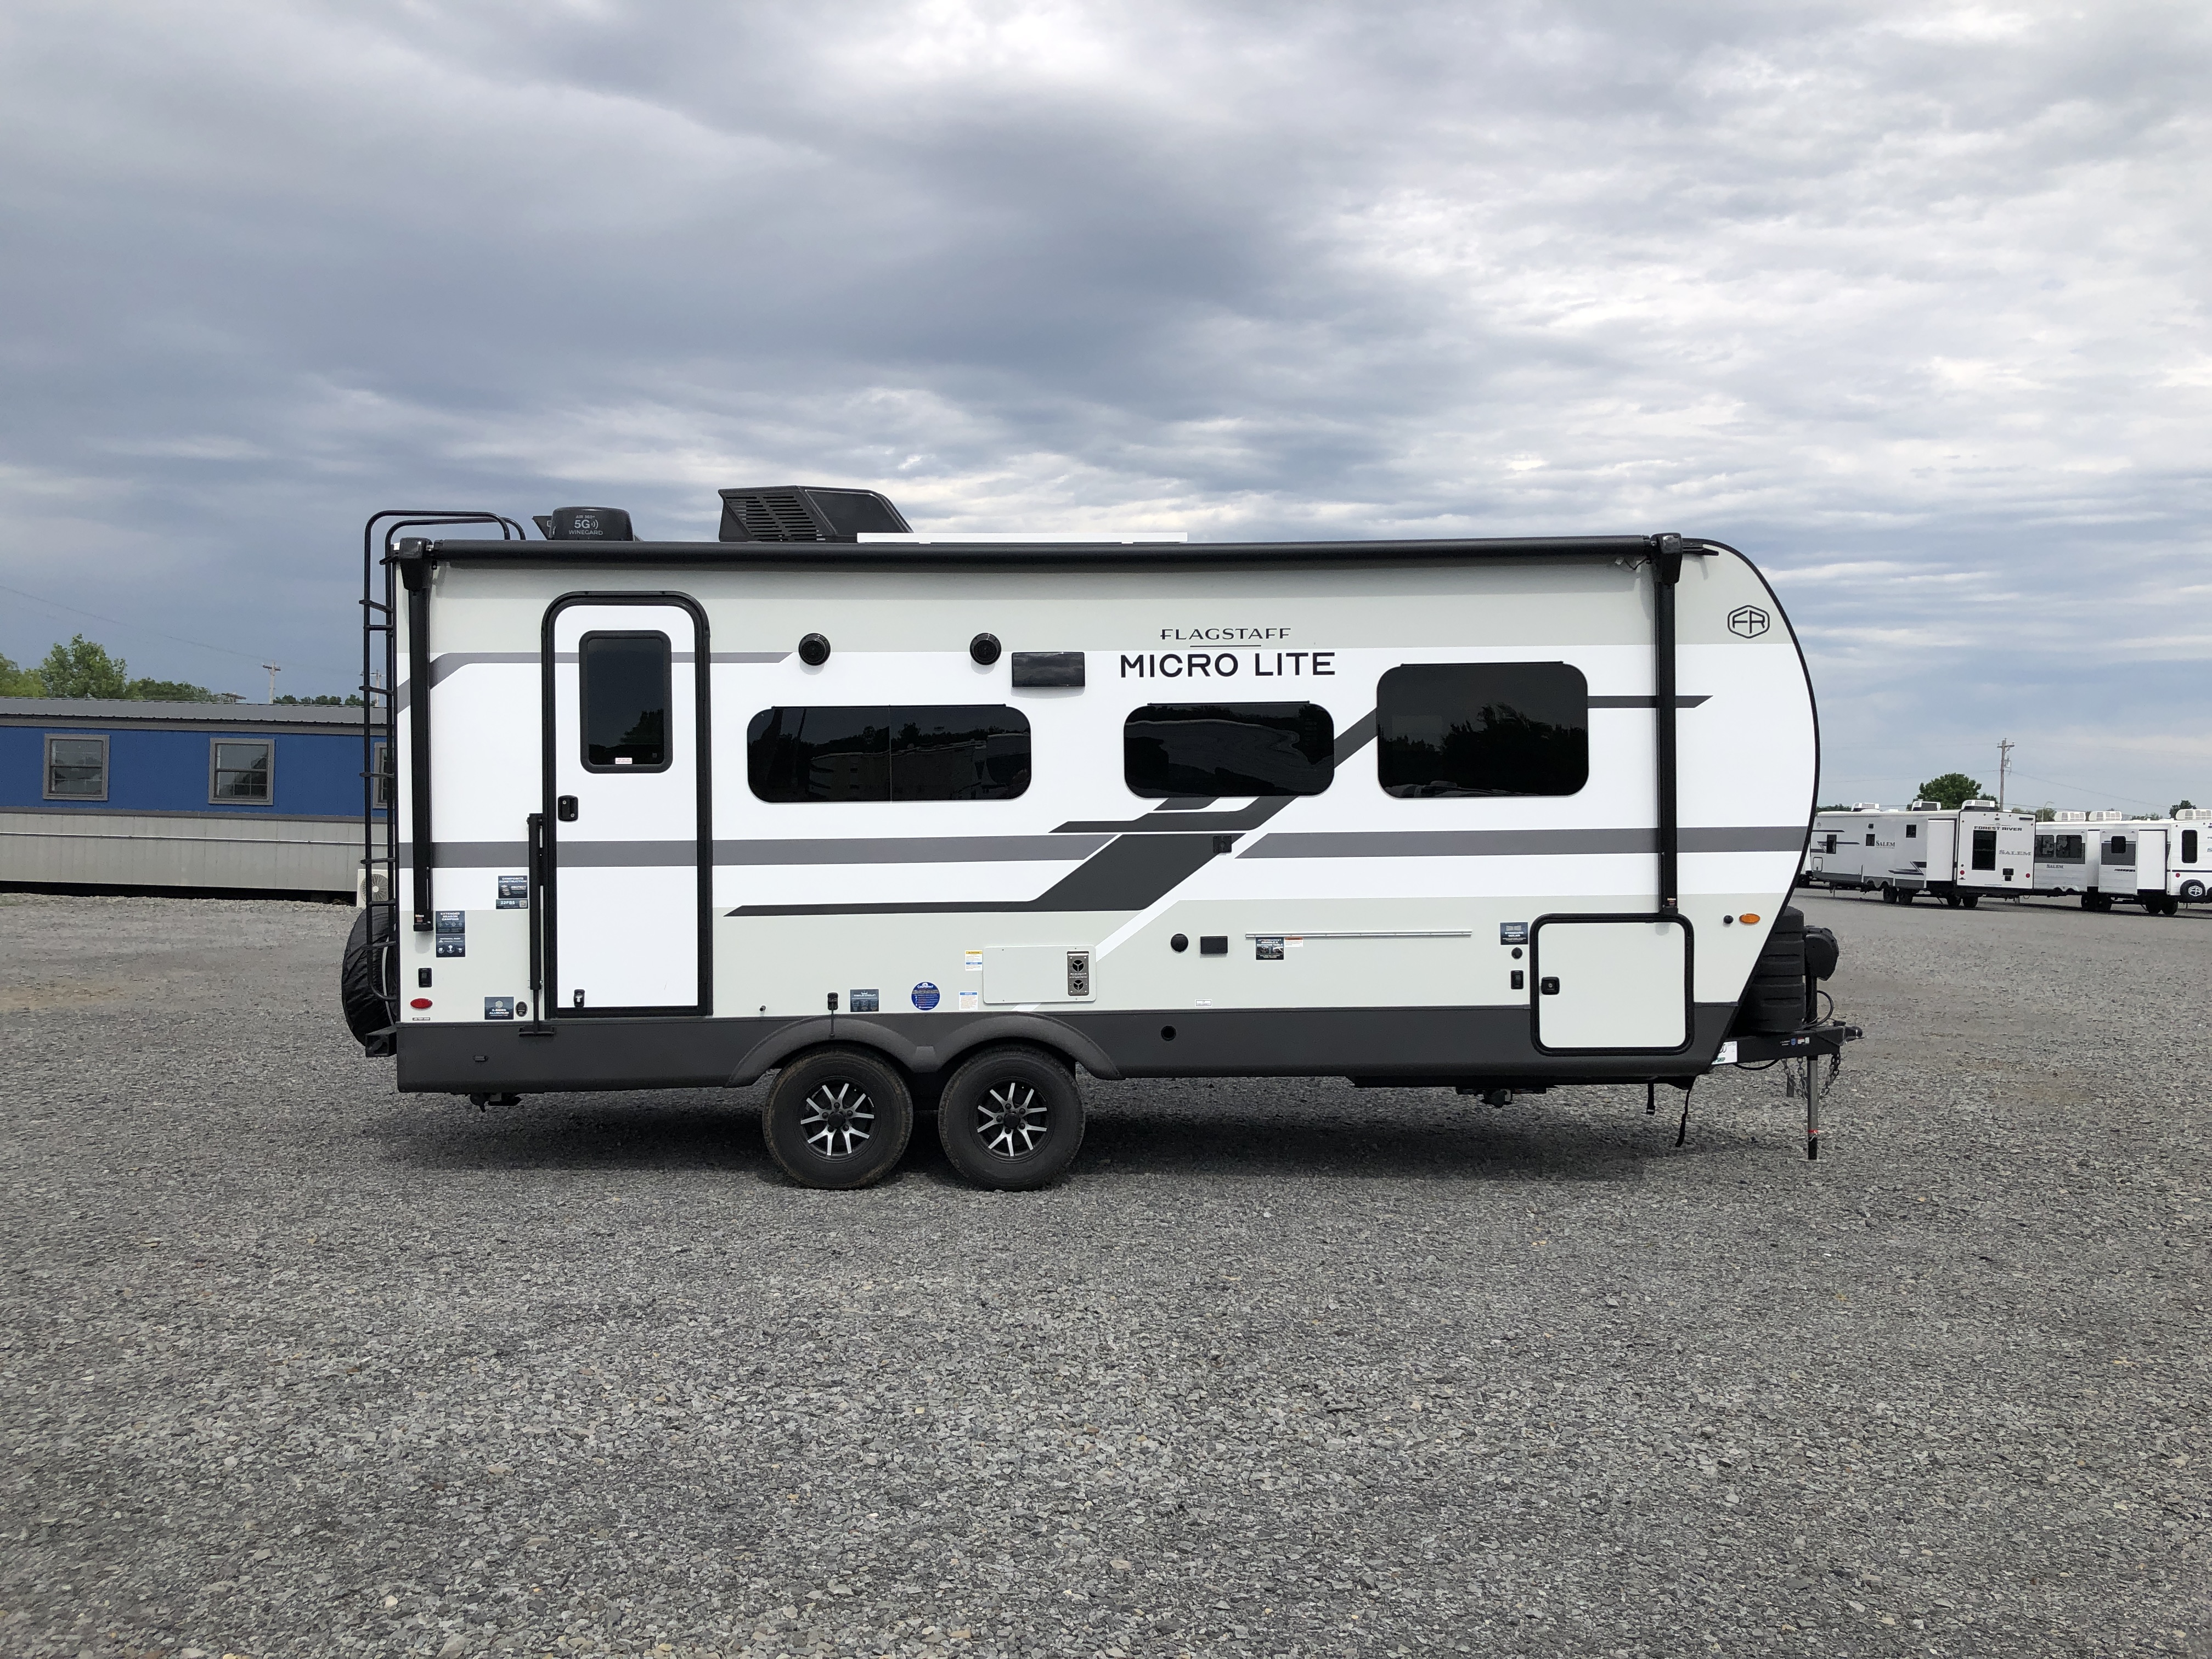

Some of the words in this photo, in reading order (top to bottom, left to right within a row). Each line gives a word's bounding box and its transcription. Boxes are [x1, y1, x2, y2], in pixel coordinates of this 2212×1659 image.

[574, 519, 590, 529] 5G
[1160, 628, 1291, 640] FLAGSTAFF
[1120, 652, 1239, 678] MICRO
[1255, 652, 1335, 676] LITE
